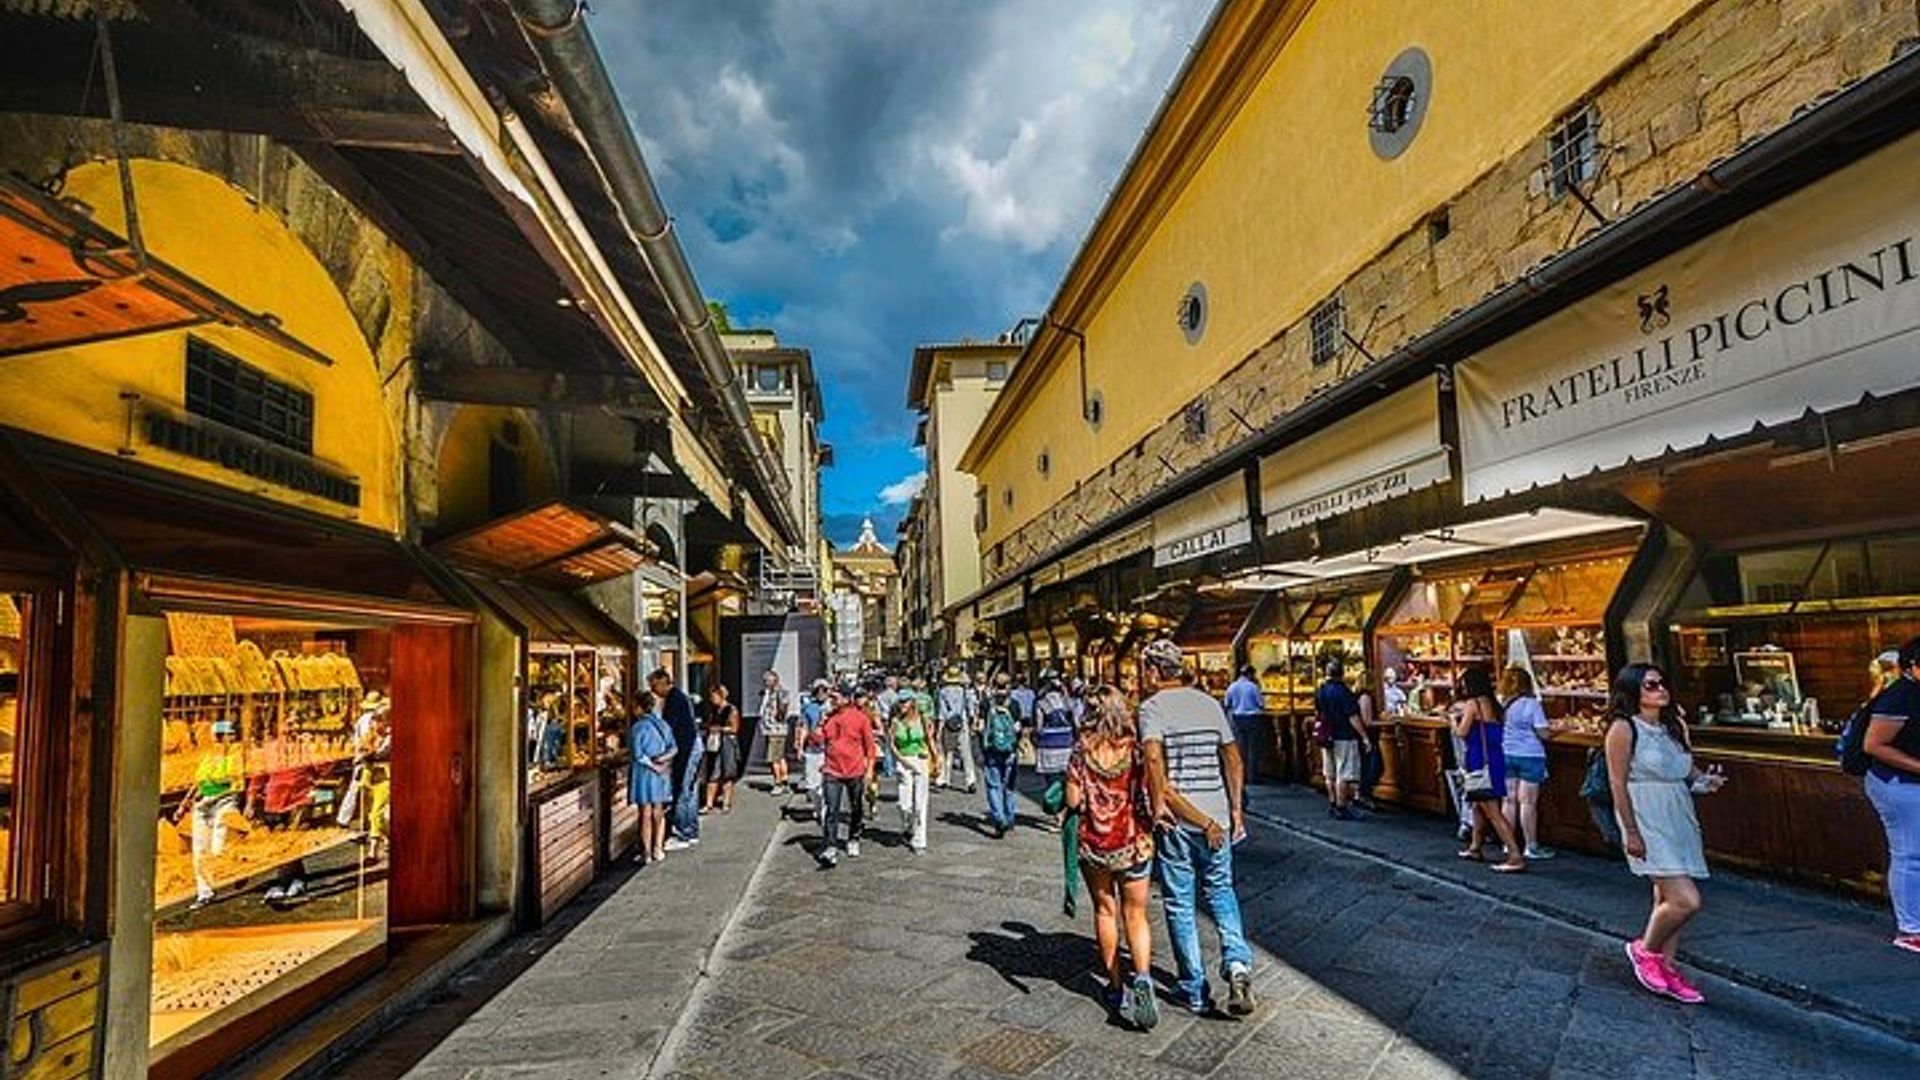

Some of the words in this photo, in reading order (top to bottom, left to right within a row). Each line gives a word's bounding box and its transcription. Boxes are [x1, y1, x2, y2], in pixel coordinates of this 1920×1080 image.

[1501, 337, 1677, 429] FRATELLI
[1689, 238, 1918, 361] PICCINI
[1624, 363, 1706, 403] FIRENZE
[1290, 495, 1343, 521] FRATELLI
